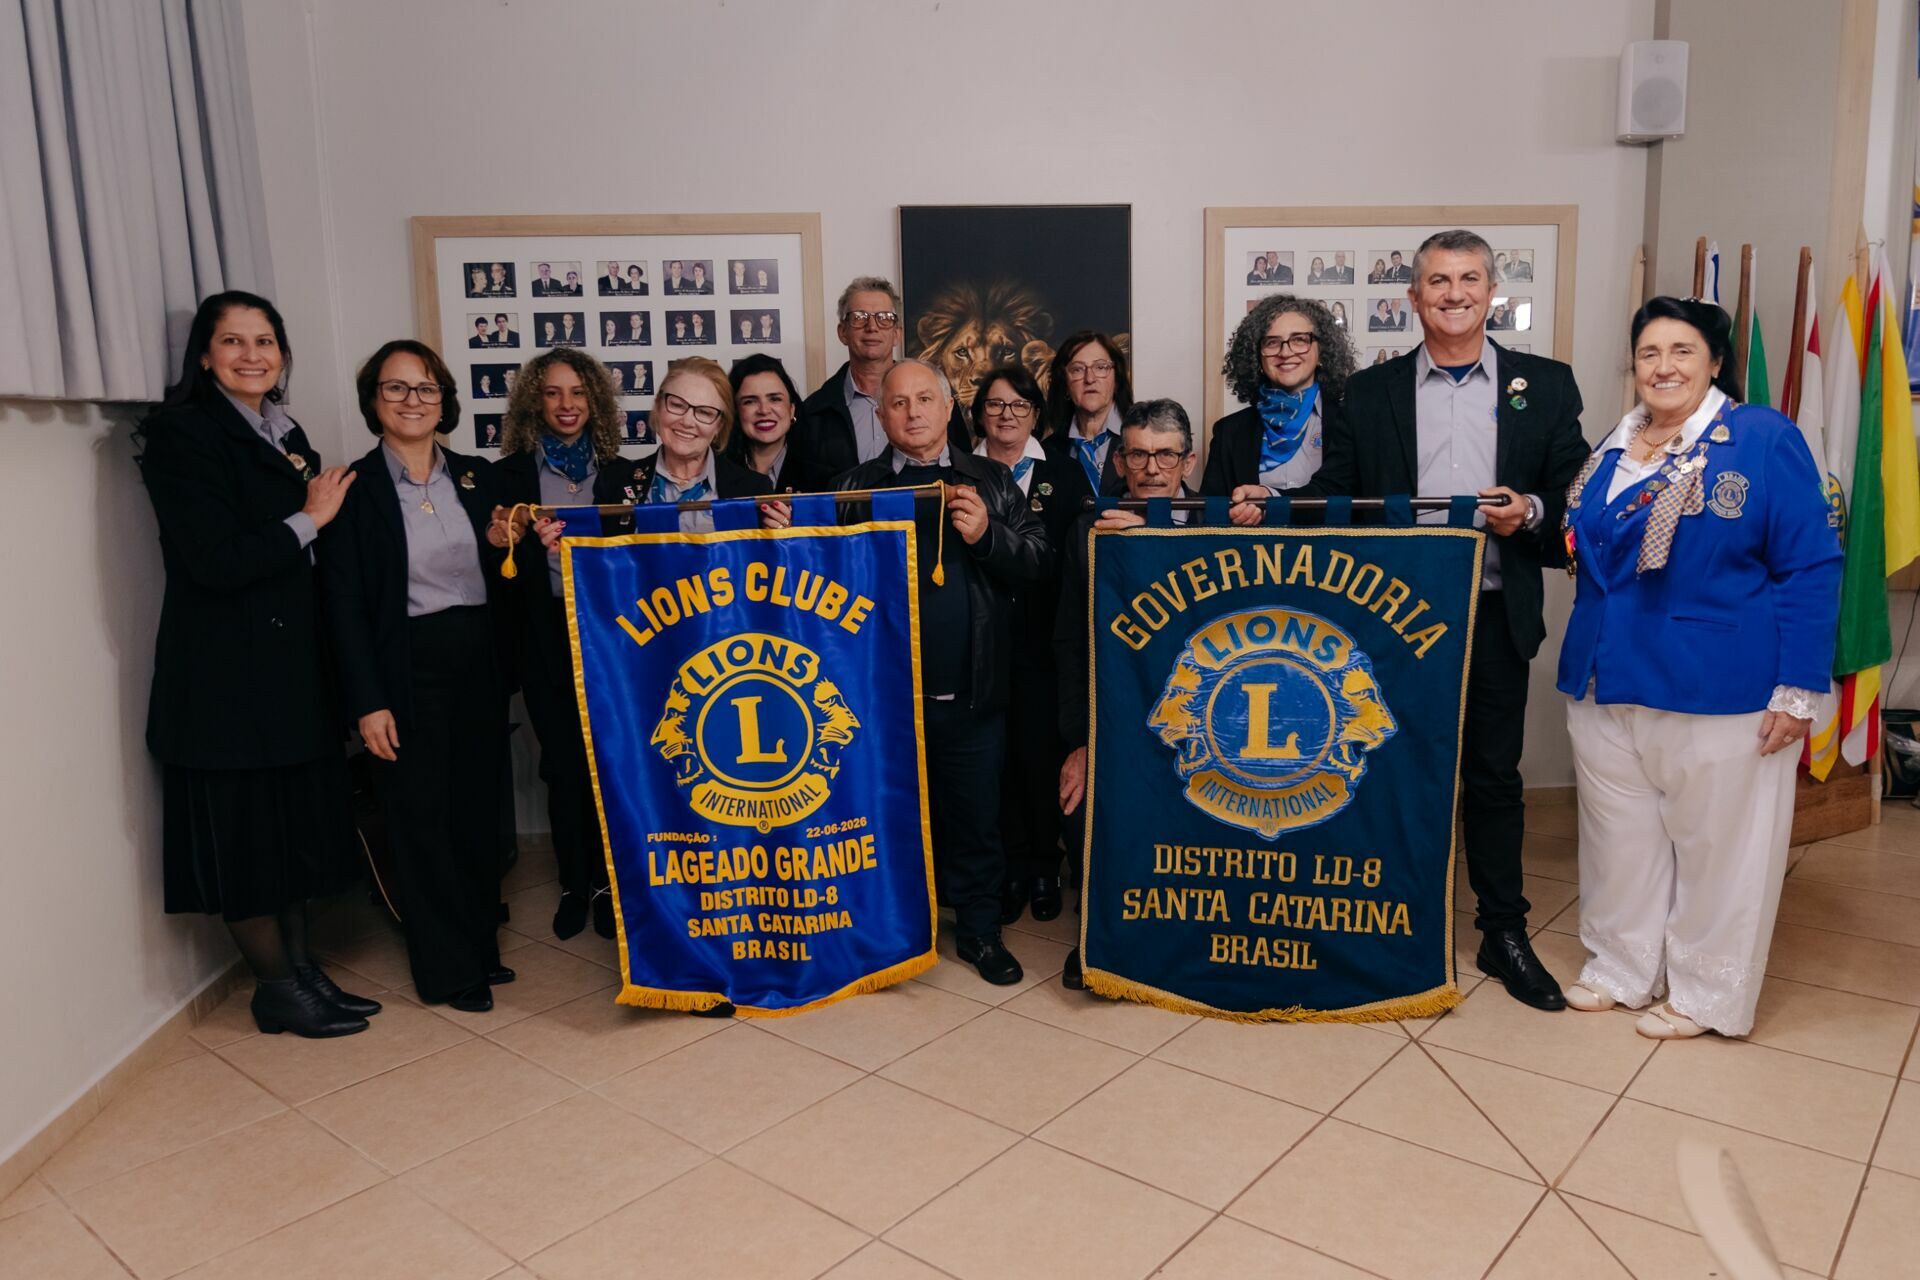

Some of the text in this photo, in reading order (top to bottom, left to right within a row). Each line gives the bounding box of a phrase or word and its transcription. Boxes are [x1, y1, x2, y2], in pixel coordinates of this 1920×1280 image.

[616, 561, 875, 647] LIONS CLUBE
[1110, 543, 1448, 660] GOVERNADORIA
[1202, 615, 1342, 663] LIONS
[686, 639, 813, 689] LIONS
[731, 696, 787, 764] L
[1240, 683, 1301, 760] L
[699, 783, 821, 818] INTERNATIONAL
[1198, 778, 1337, 818] INTERNATIONAL
[647, 832, 710, 844] FUNDAÇÃO
[806, 816, 868, 839] 22-06-2026
[648, 834, 877, 887] LAGEADO GRANDE
[1153, 844, 1382, 888] DISTRITO LD-8
[700, 885, 839, 911] DISTRITO LD-8
[1122, 887, 1413, 936] SANTA CATARINA
[687, 909, 853, 938] SANTA CATARINA
[732, 939, 812, 962] BRASIL
[1209, 934, 1318, 970] BRASIL
